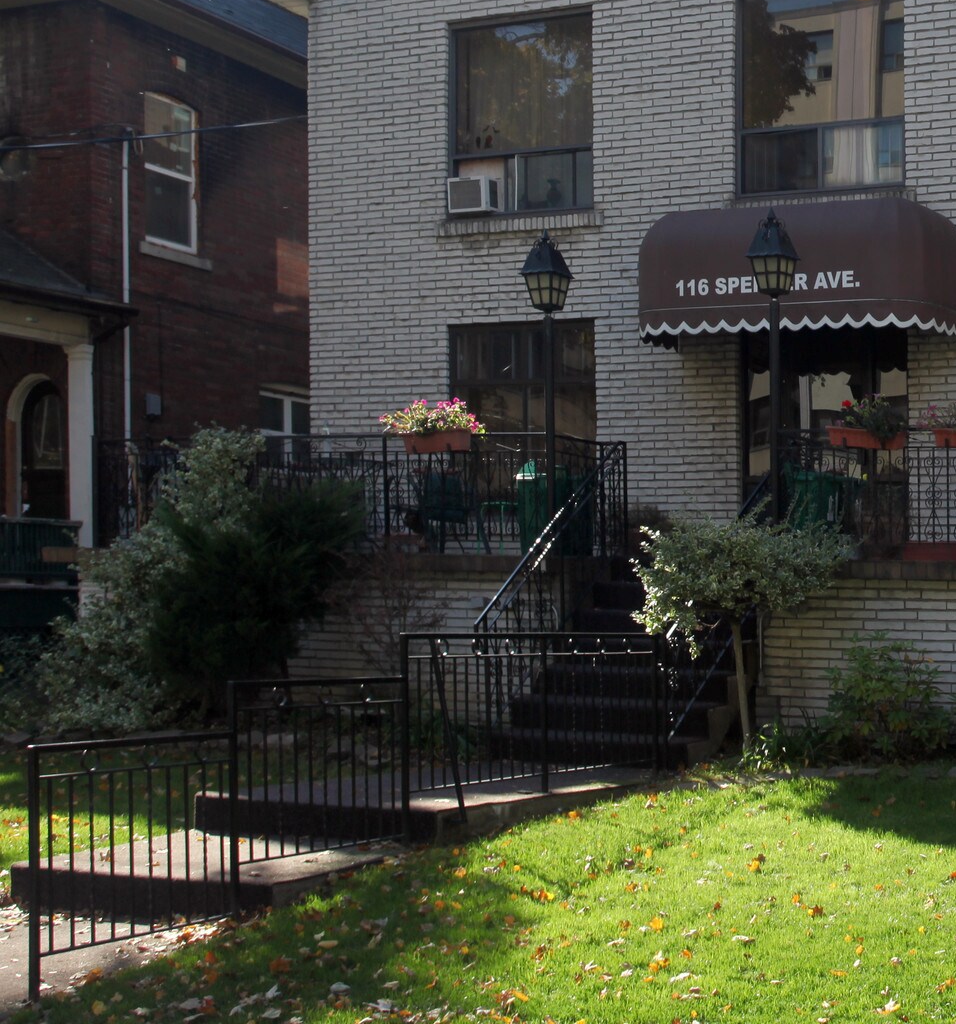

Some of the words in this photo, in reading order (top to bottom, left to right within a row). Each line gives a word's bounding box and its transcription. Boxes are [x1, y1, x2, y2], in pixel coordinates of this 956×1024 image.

[675, 278, 709, 296] 116
[715, 273, 808, 294] SPER
[813, 270, 860, 290] AVE.
